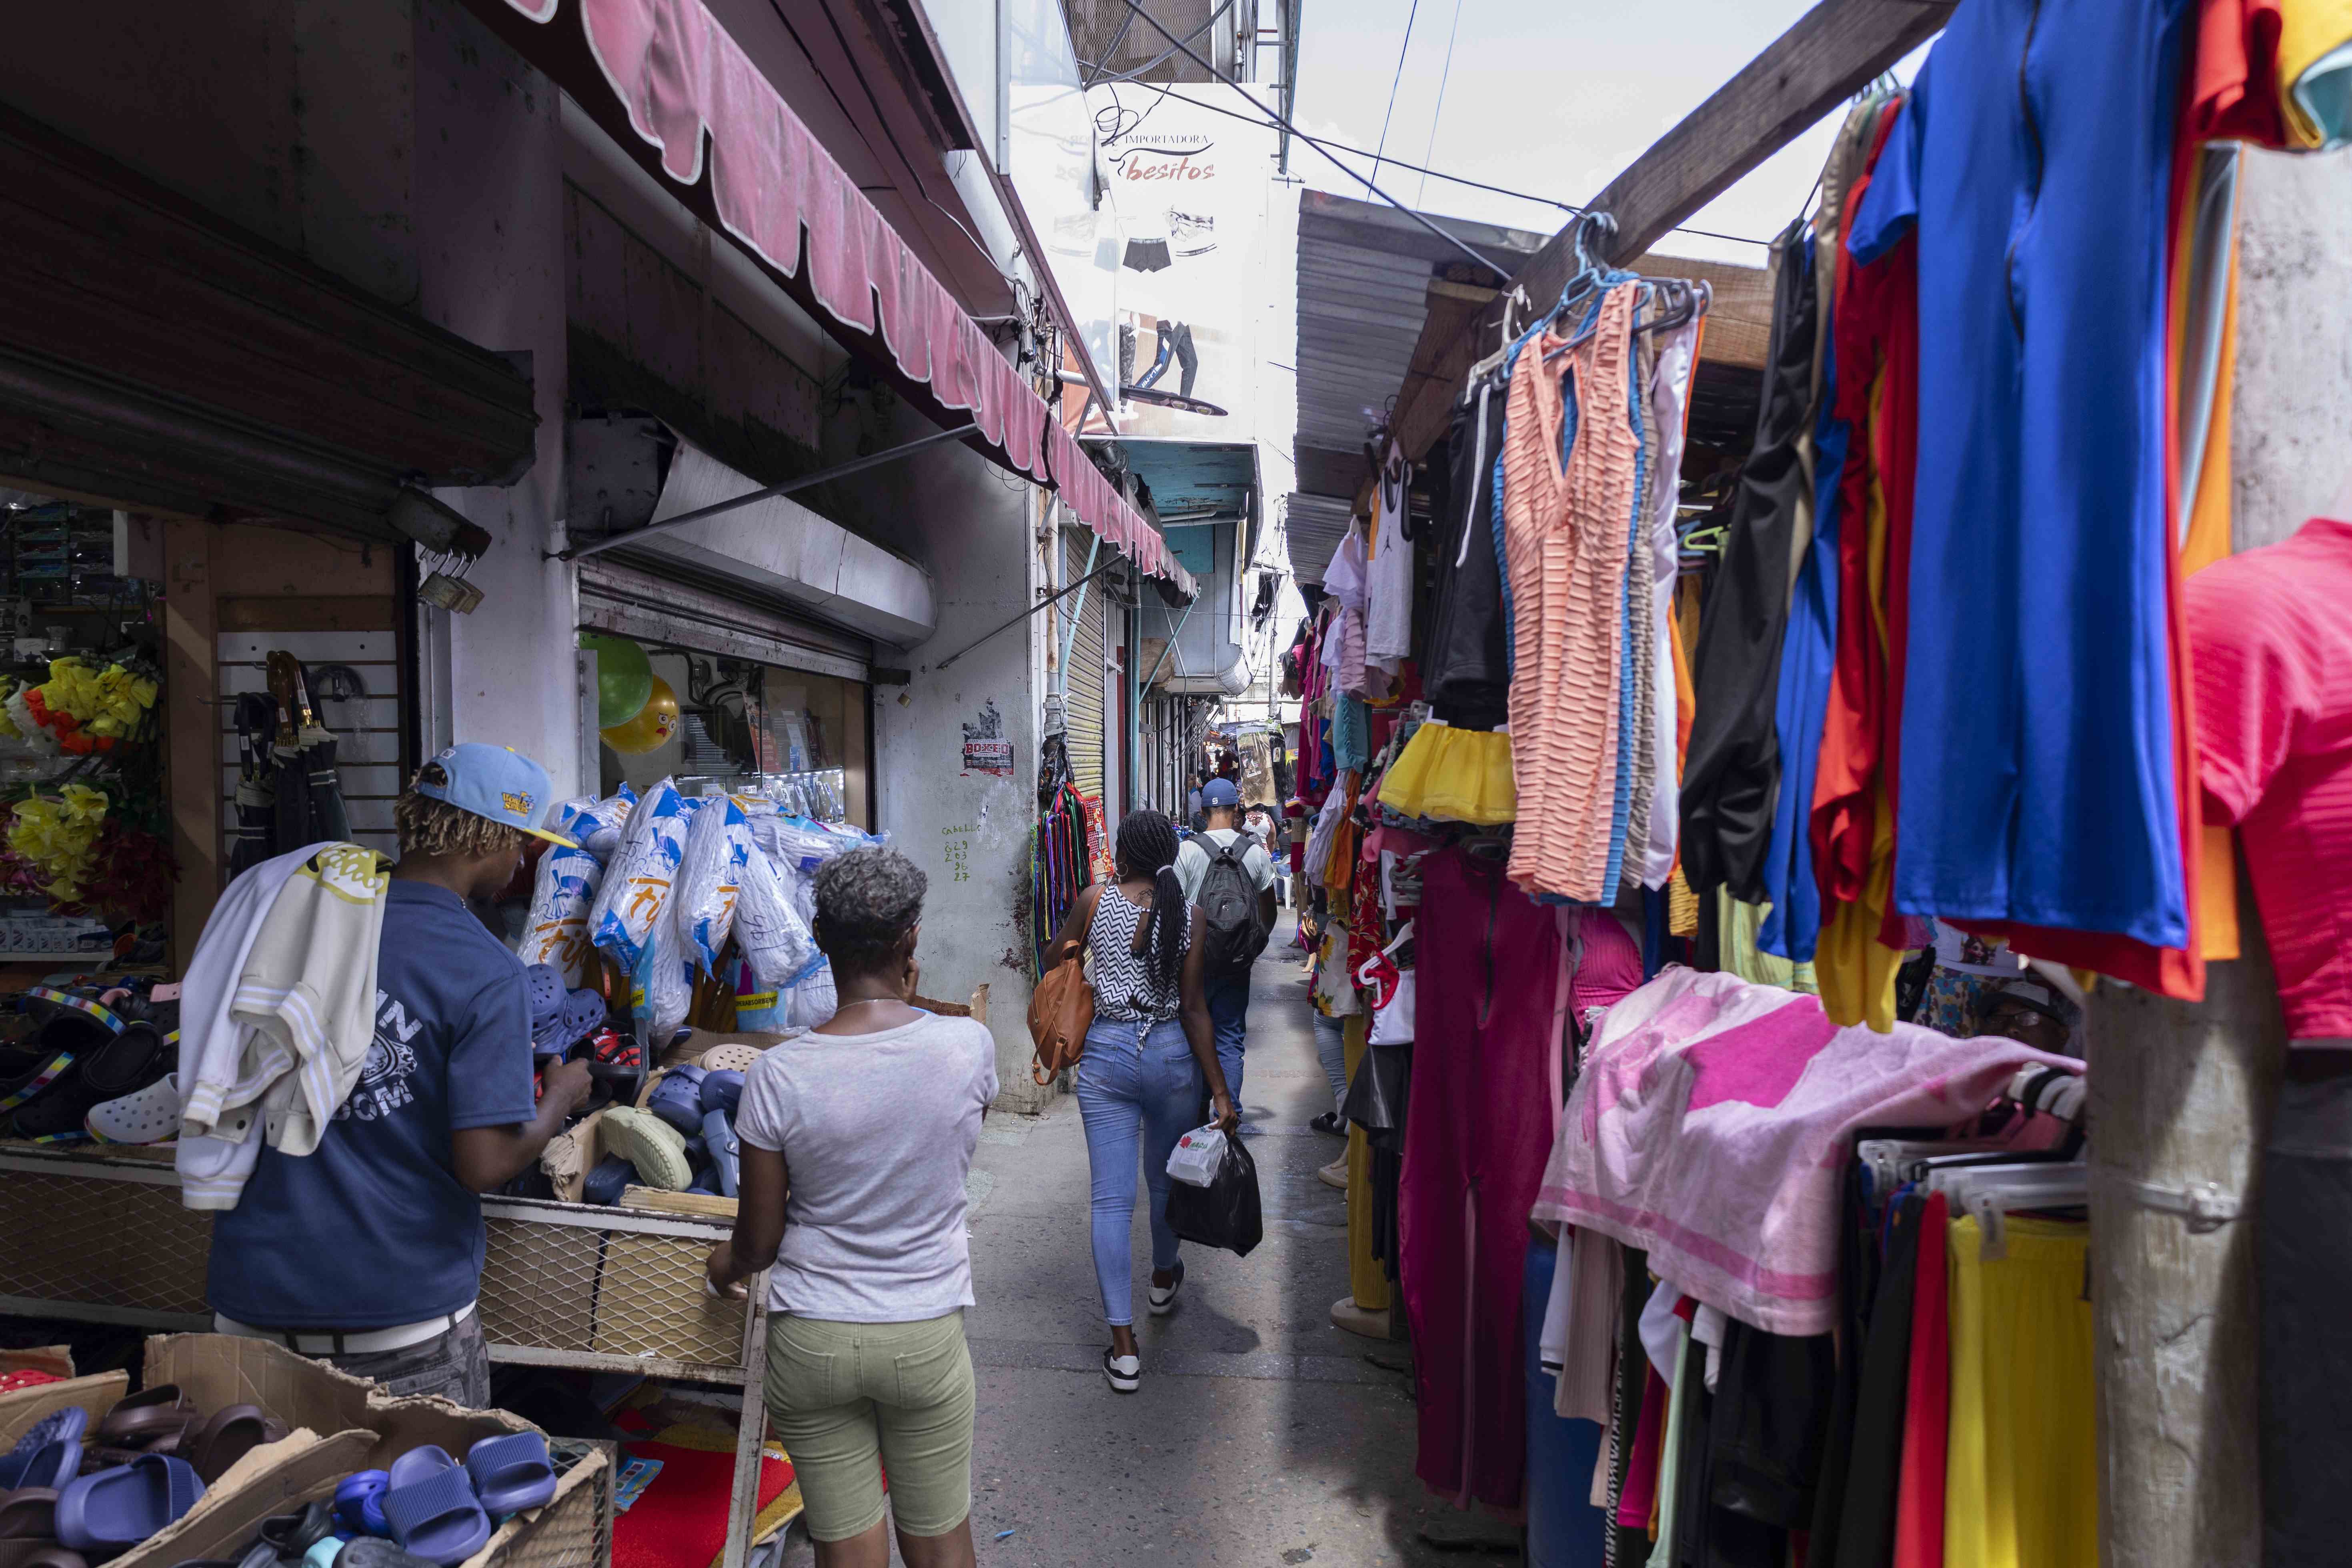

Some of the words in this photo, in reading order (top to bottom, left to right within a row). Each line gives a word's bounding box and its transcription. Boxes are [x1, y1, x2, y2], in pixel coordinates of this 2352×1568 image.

[1125, 135, 1208, 144] IMPORTADORA
[1126, 155, 1215, 180] besitos
[965, 743, 1009, 755] BOXEO
